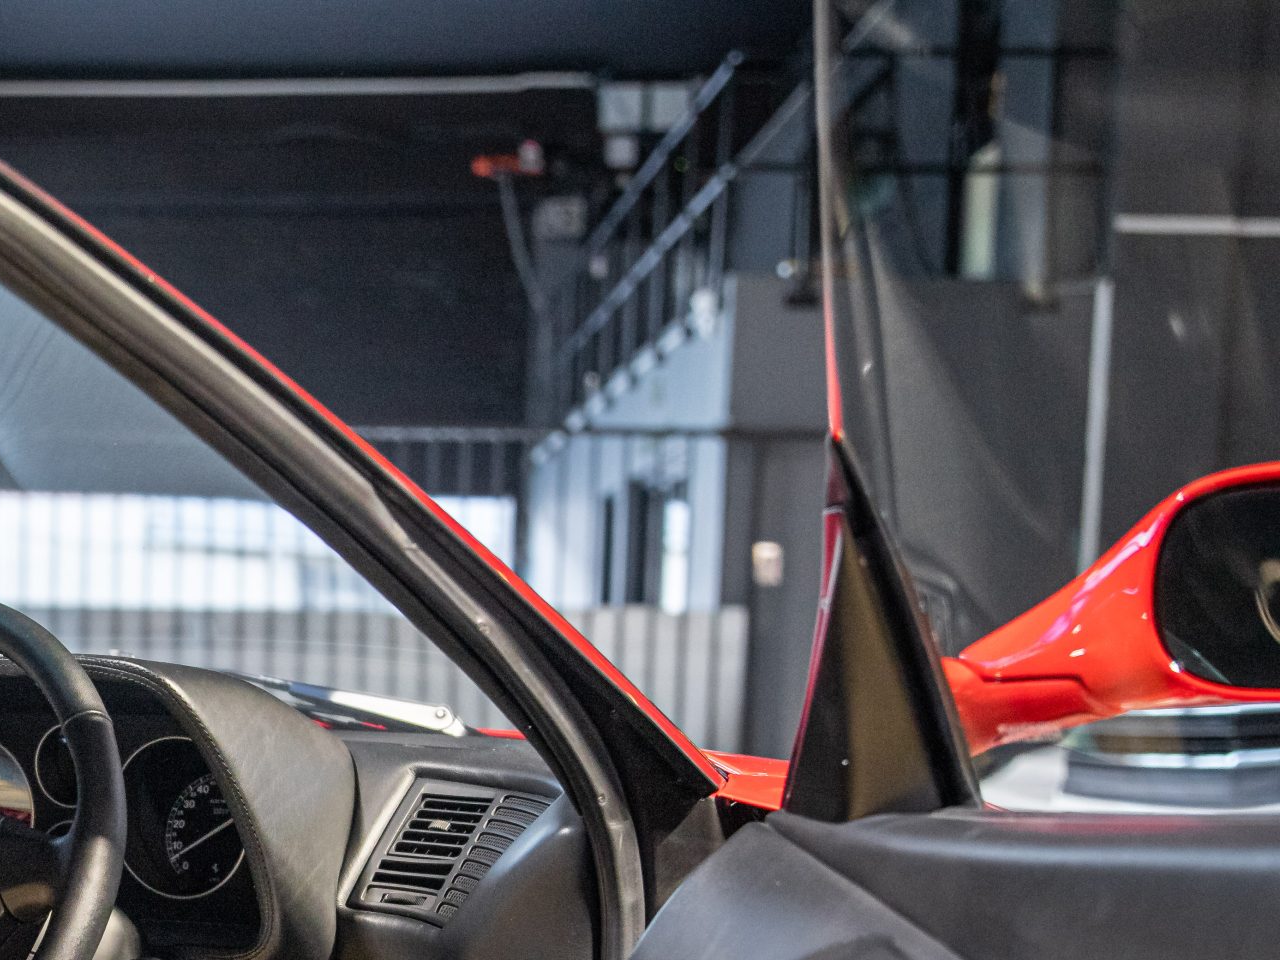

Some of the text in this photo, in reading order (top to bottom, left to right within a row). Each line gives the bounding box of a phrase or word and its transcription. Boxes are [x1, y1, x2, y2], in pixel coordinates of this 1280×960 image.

[196, 784, 210, 794] 40
[183, 799, 196, 809] 30
[173, 819, 186, 829] 20
[172, 840, 183, 850] 10
[182, 861, 189, 870] 0
